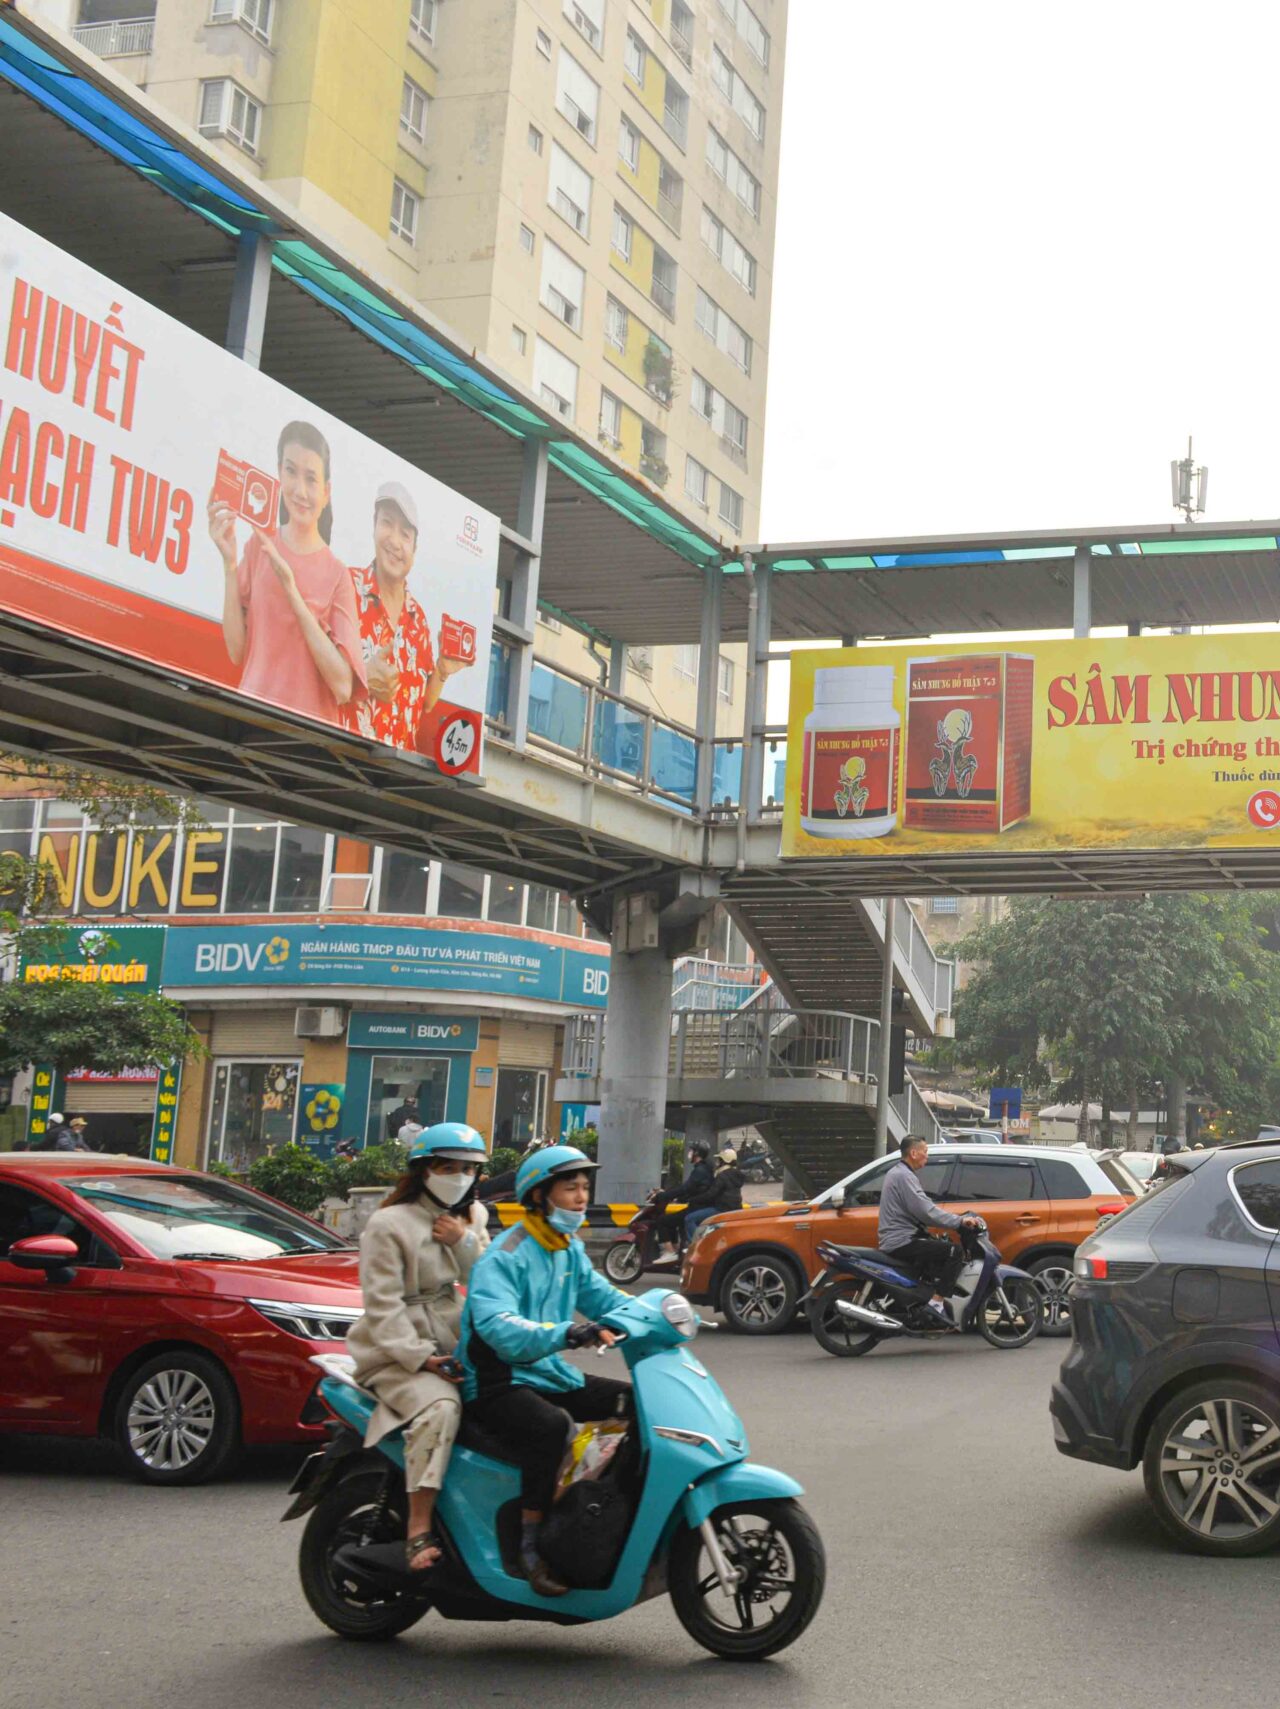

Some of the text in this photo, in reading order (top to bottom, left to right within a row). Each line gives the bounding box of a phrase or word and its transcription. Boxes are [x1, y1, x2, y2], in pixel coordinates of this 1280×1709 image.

[4, 276, 146, 433] HUYẾT
[0, 398, 194, 575] ẠCH TW3
[1047, 661, 1152, 731] SÂM
[446, 727, 469, 754] 4,5m
[1131, 738, 1166, 766] Trị
[1172, 736, 1248, 762] chứng
[1212, 767, 1255, 783] Thuốc
[195, 942, 267, 973] BIDV
[300, 940, 328, 954] NGÂN
[329, 941, 360, 954] HÀNG
[363, 943, 394, 955] TMCP
[396, 943, 419, 958] ĐẦU
[421, 946, 438, 959] TƯ
[439, 947, 452, 960] VÀ
[455, 947, 481, 961] PHÁT
[483, 950, 509, 965] TRIỂN
[509, 953, 526, 969] VIỆT
[526, 958, 541, 970] NAM
[583, 967, 610, 996] BID
[368, 1024, 451, 1039] AUTOBANK BIDV
